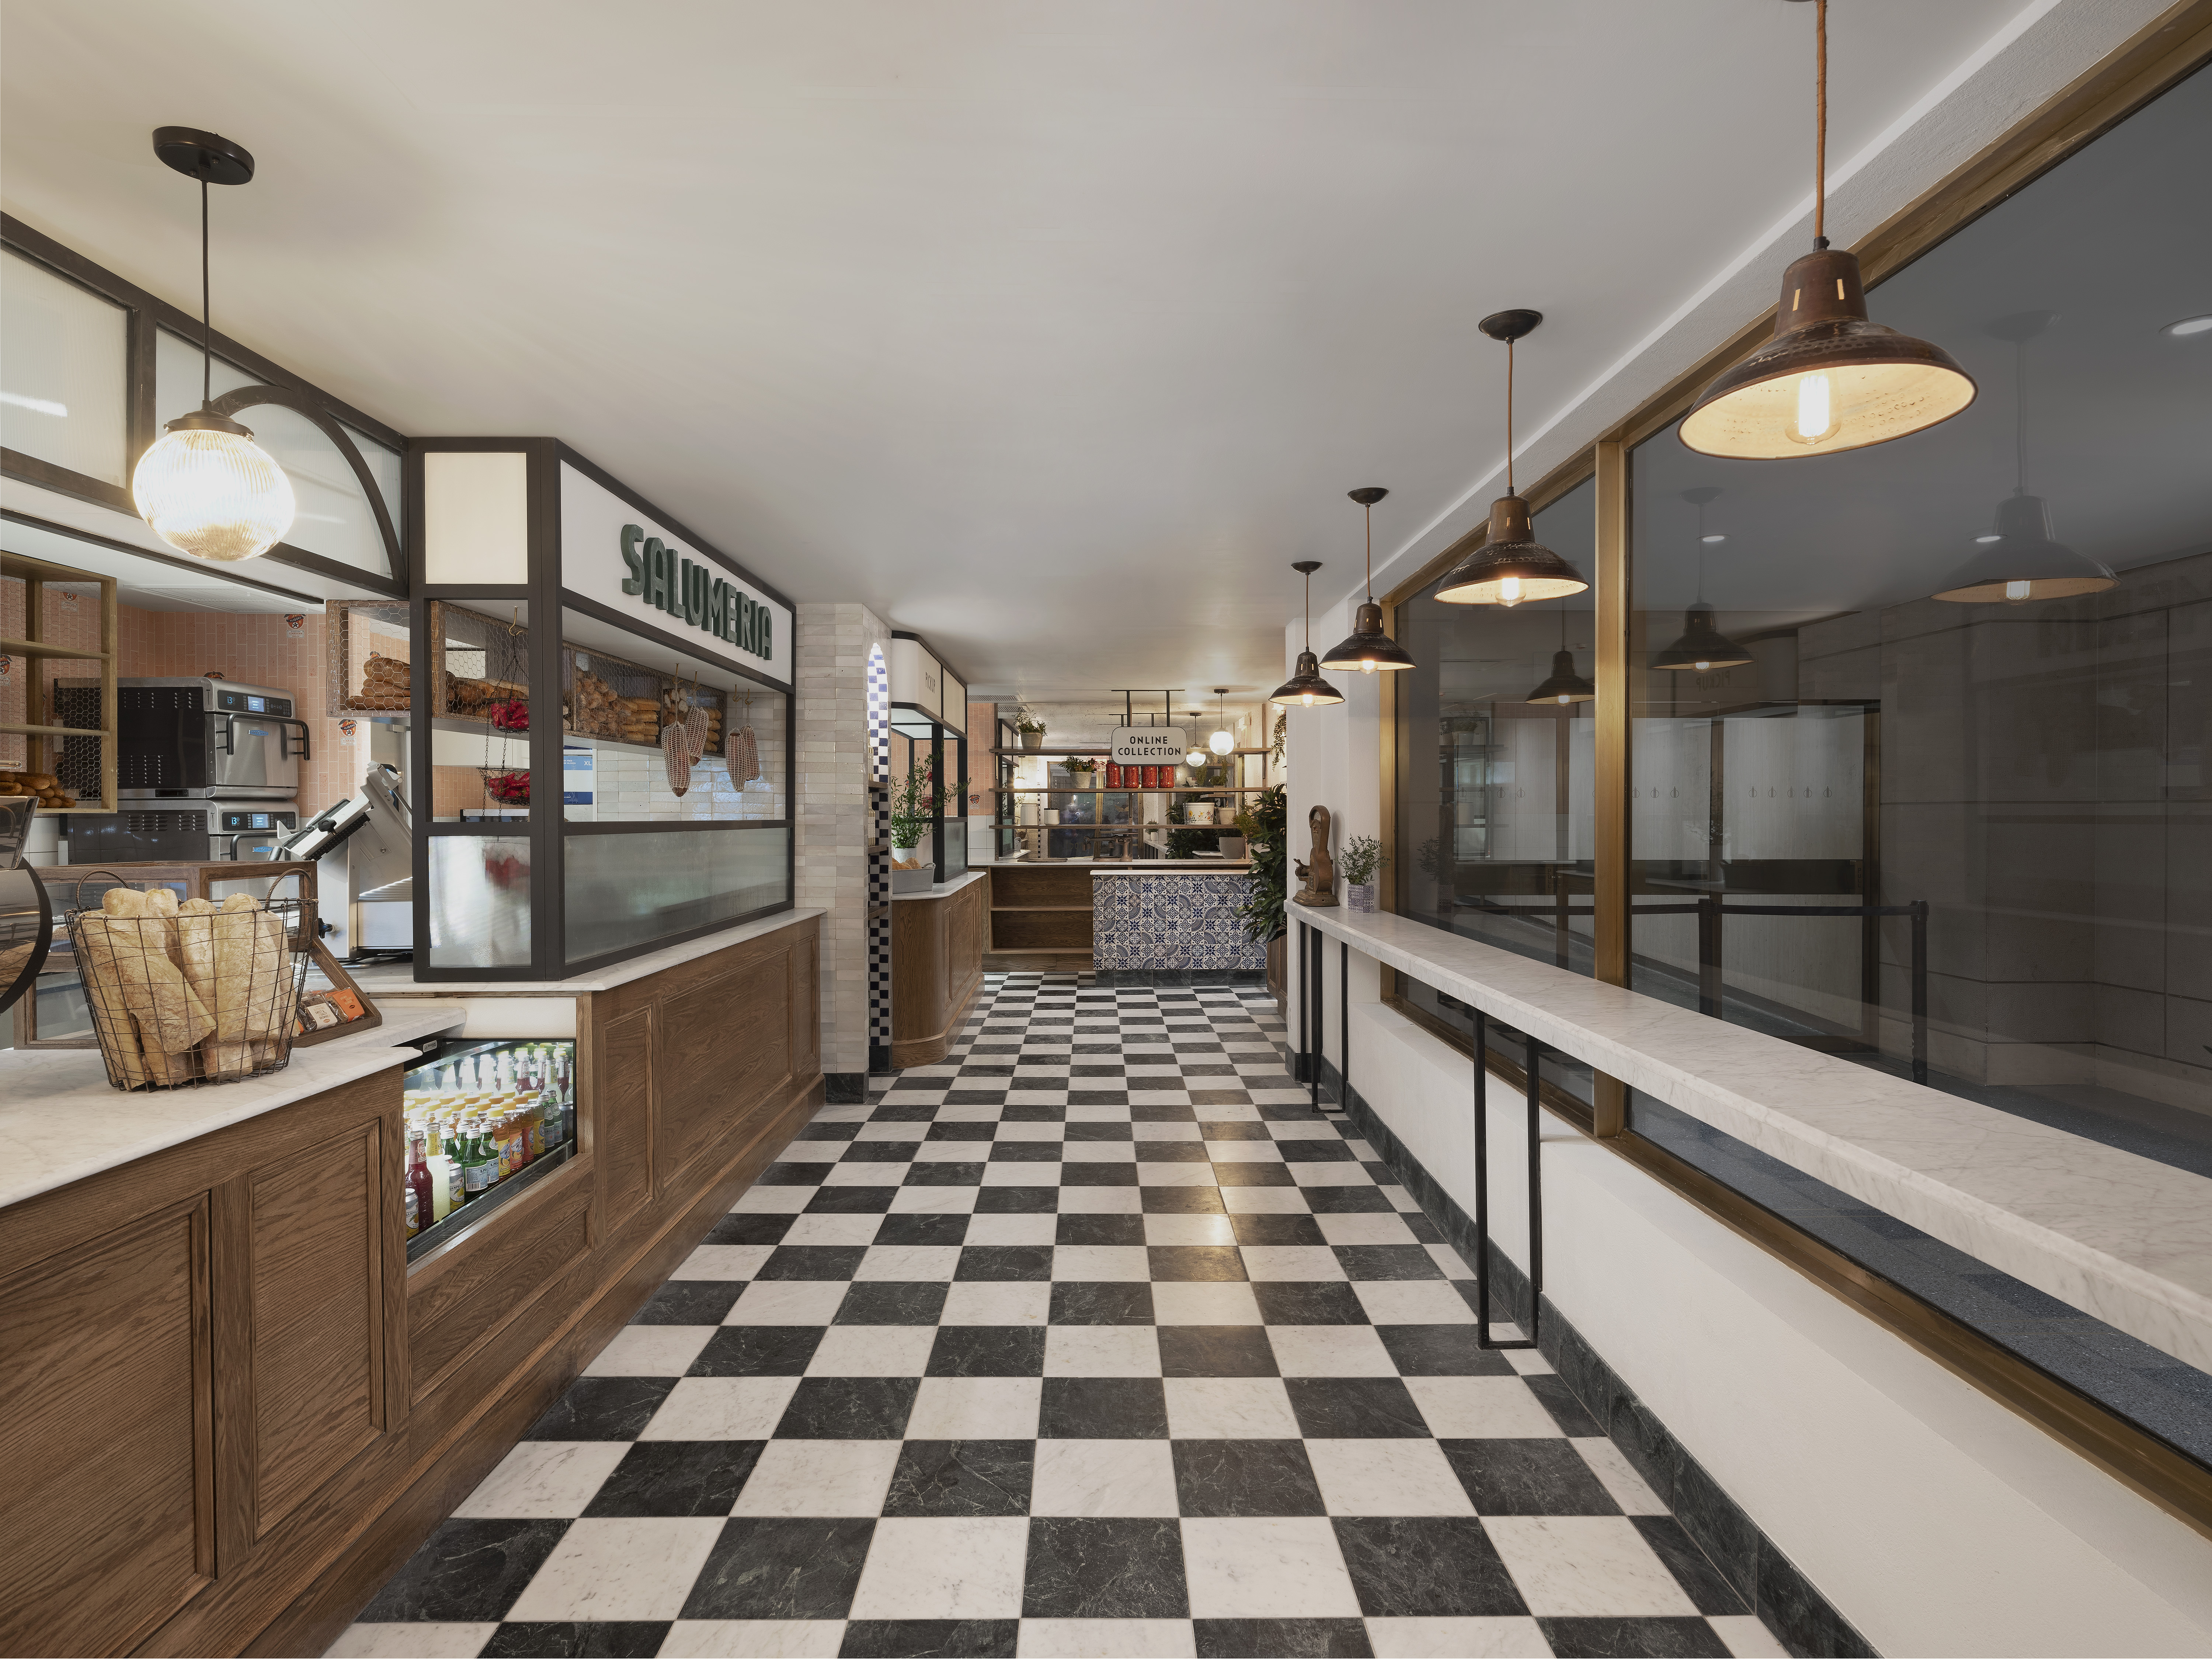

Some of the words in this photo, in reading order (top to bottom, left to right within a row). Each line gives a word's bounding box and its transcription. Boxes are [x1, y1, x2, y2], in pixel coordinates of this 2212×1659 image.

[620, 524, 772, 660] SALUMERIA
[925, 671, 936, 693] PICKUP
[1130, 736, 1168, 744] ONLINE
[1118, 747, 1181, 755] COLLECTION
